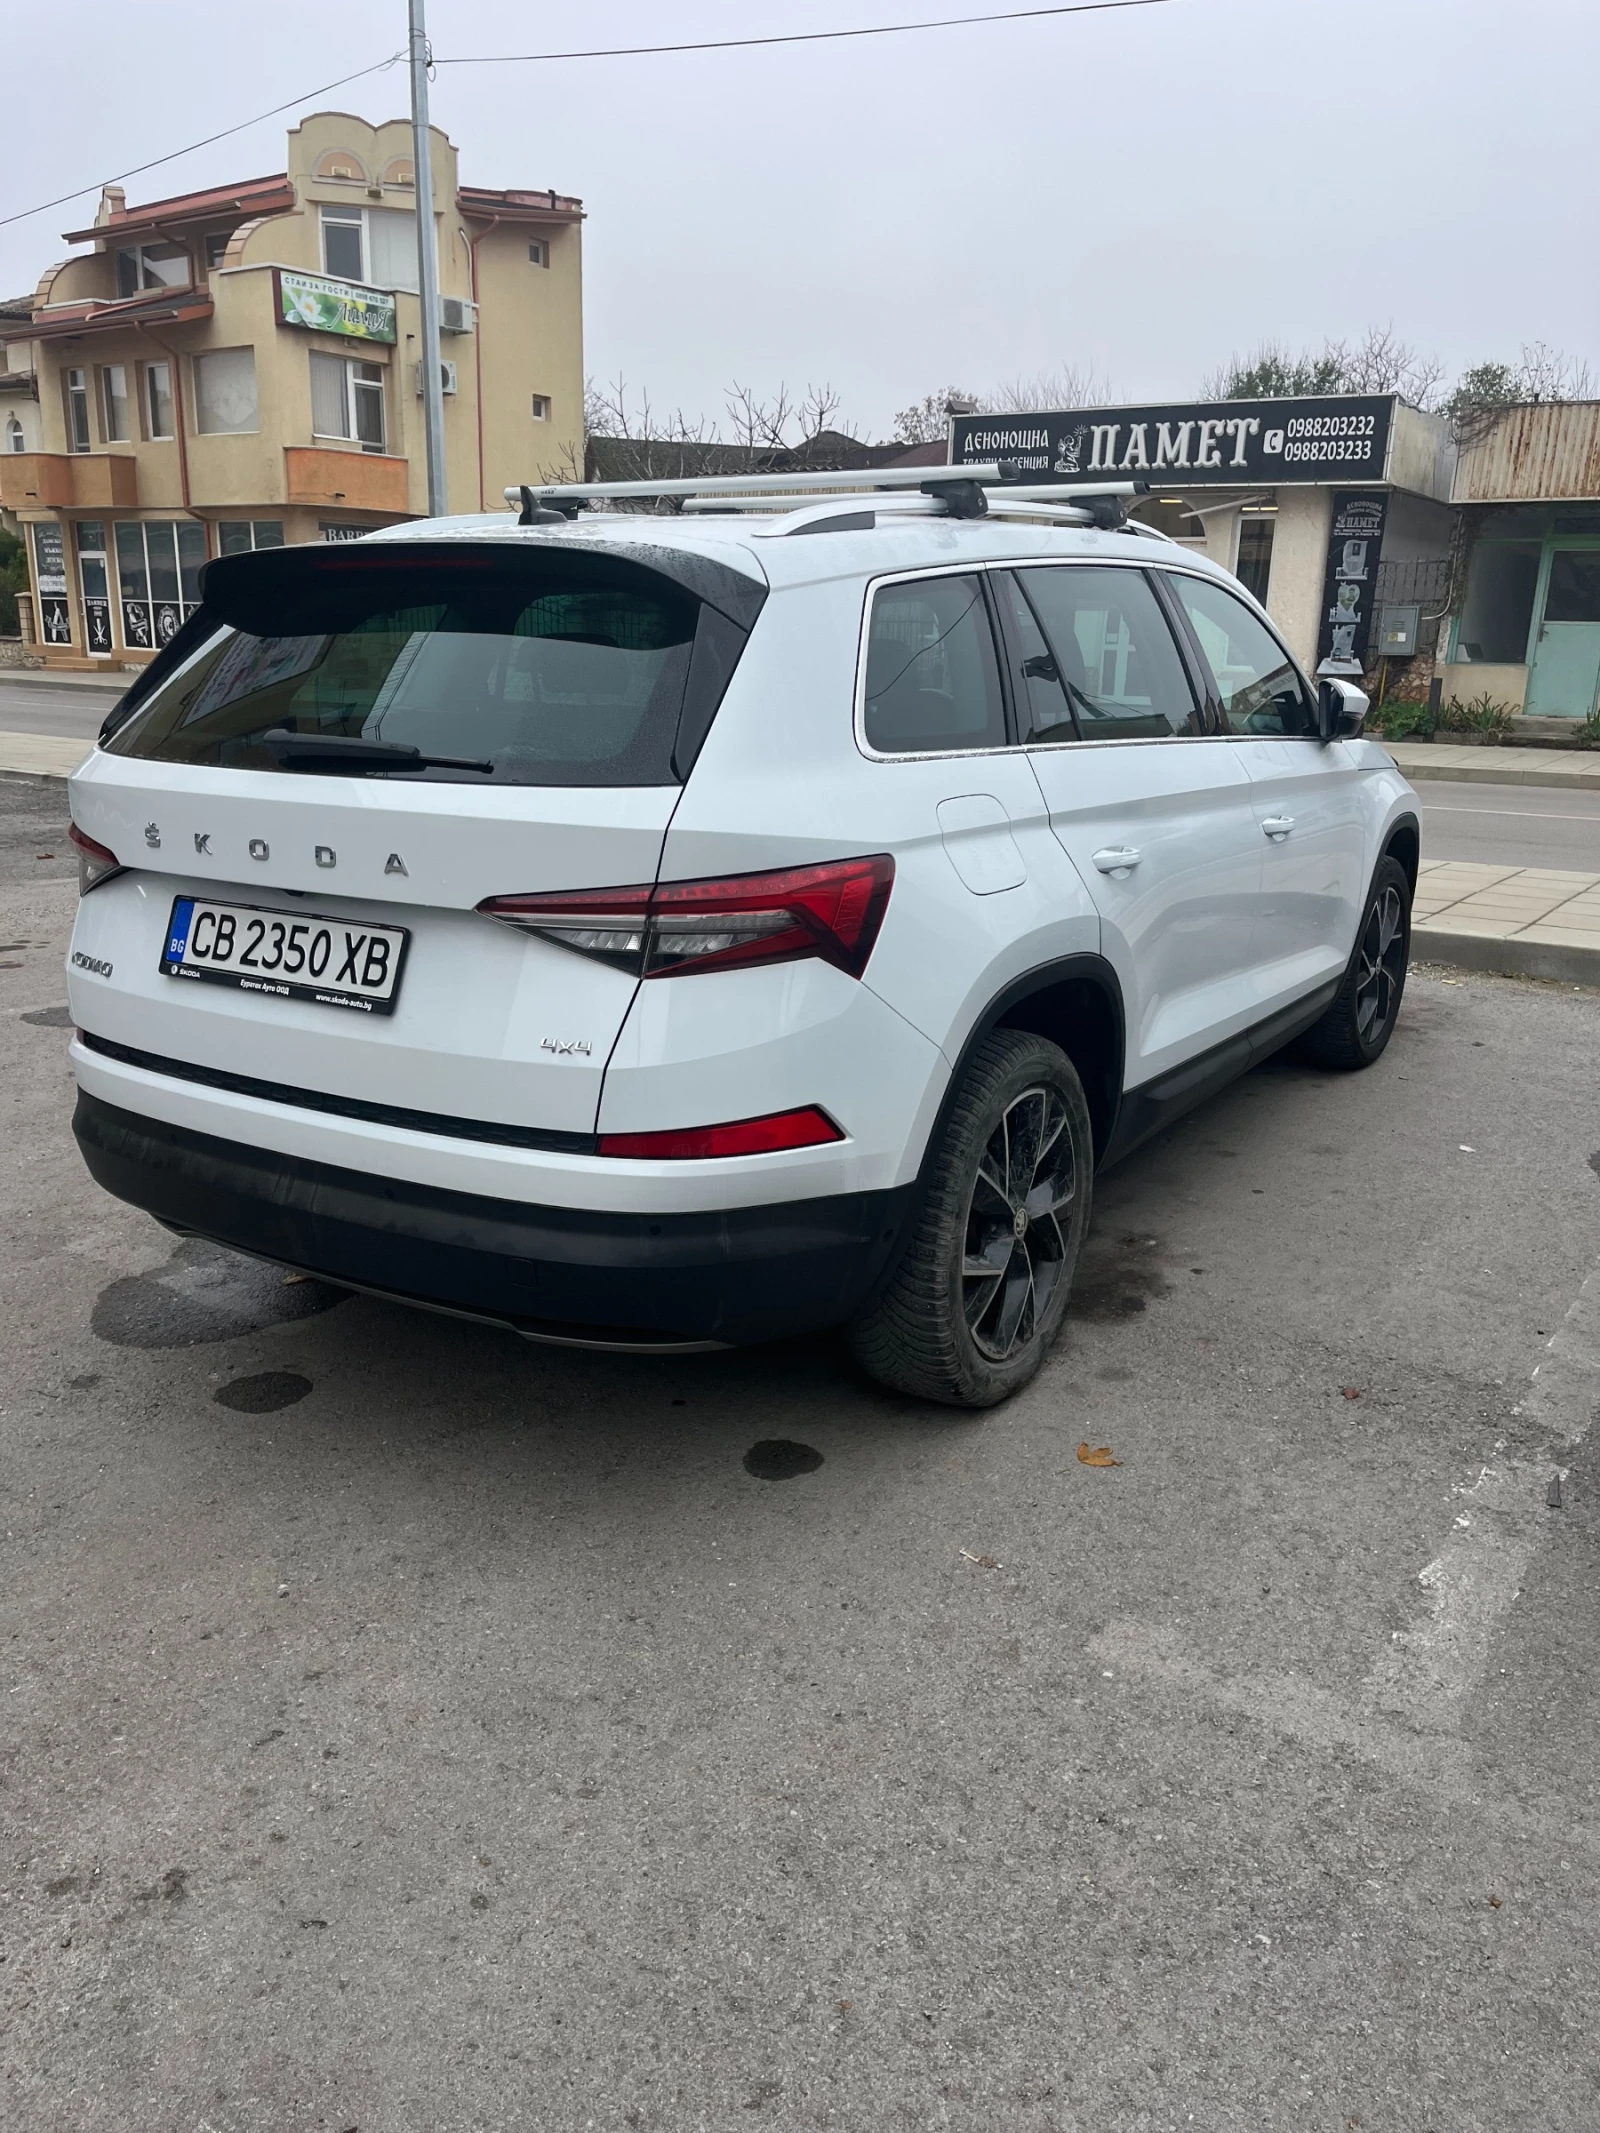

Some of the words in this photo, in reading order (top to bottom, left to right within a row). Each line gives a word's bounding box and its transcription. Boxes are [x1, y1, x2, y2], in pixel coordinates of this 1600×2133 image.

[284, 277, 307, 287] СТАИ
[309, 282, 319, 290] ЗА
[323, 285, 349, 296] ГОСТИ
[1286, 415, 1375, 438] 0988203232
[964, 429, 1050, 452] ДЕНОНОЩНА
[1086, 417, 1261, 471] ПАМЕТ
[1284, 440, 1372, 461] 0988203233
[1006, 455, 1049, 471] ГЕНЦИЯ
[1346, 516, 1380, 528] ПАМЕТ
[327, 528, 372, 541] BARB
[144, 821, 410, 877] ŠKODA
[170, 938, 185, 954] BG
[239, 919, 332, 977] 2350
[276, 985, 290, 996] ООД
[315, 994, 372, 1012] www.skoda-auto.bg
